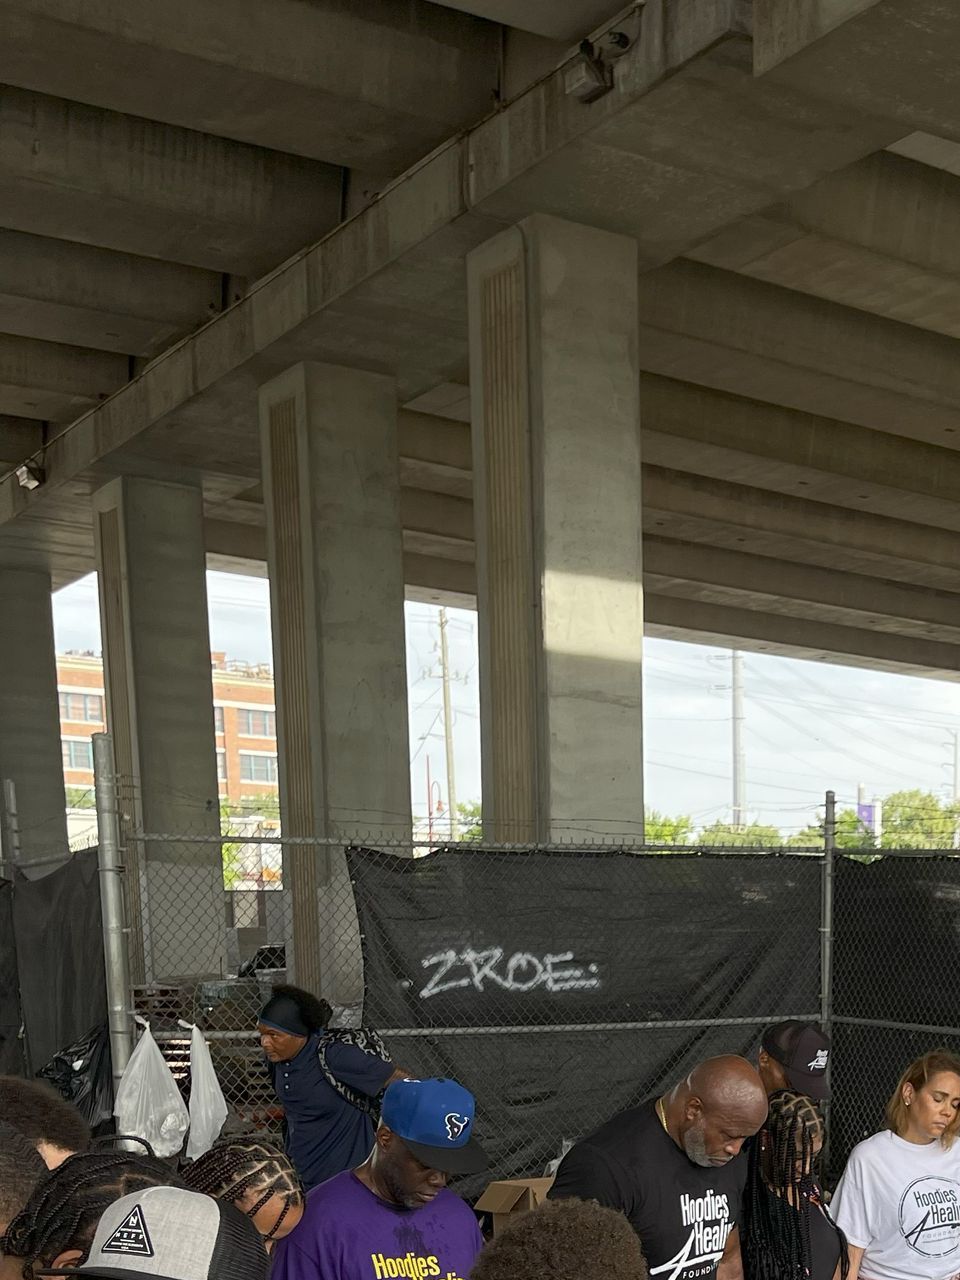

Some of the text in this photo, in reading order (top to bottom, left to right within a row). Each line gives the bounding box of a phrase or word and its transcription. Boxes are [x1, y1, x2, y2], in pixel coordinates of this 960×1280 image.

[680, 1189, 730, 1227] Hoodies
[913, 1188, 958, 1208] Hoodies
[371, 1252, 441, 1279] Hoodies
